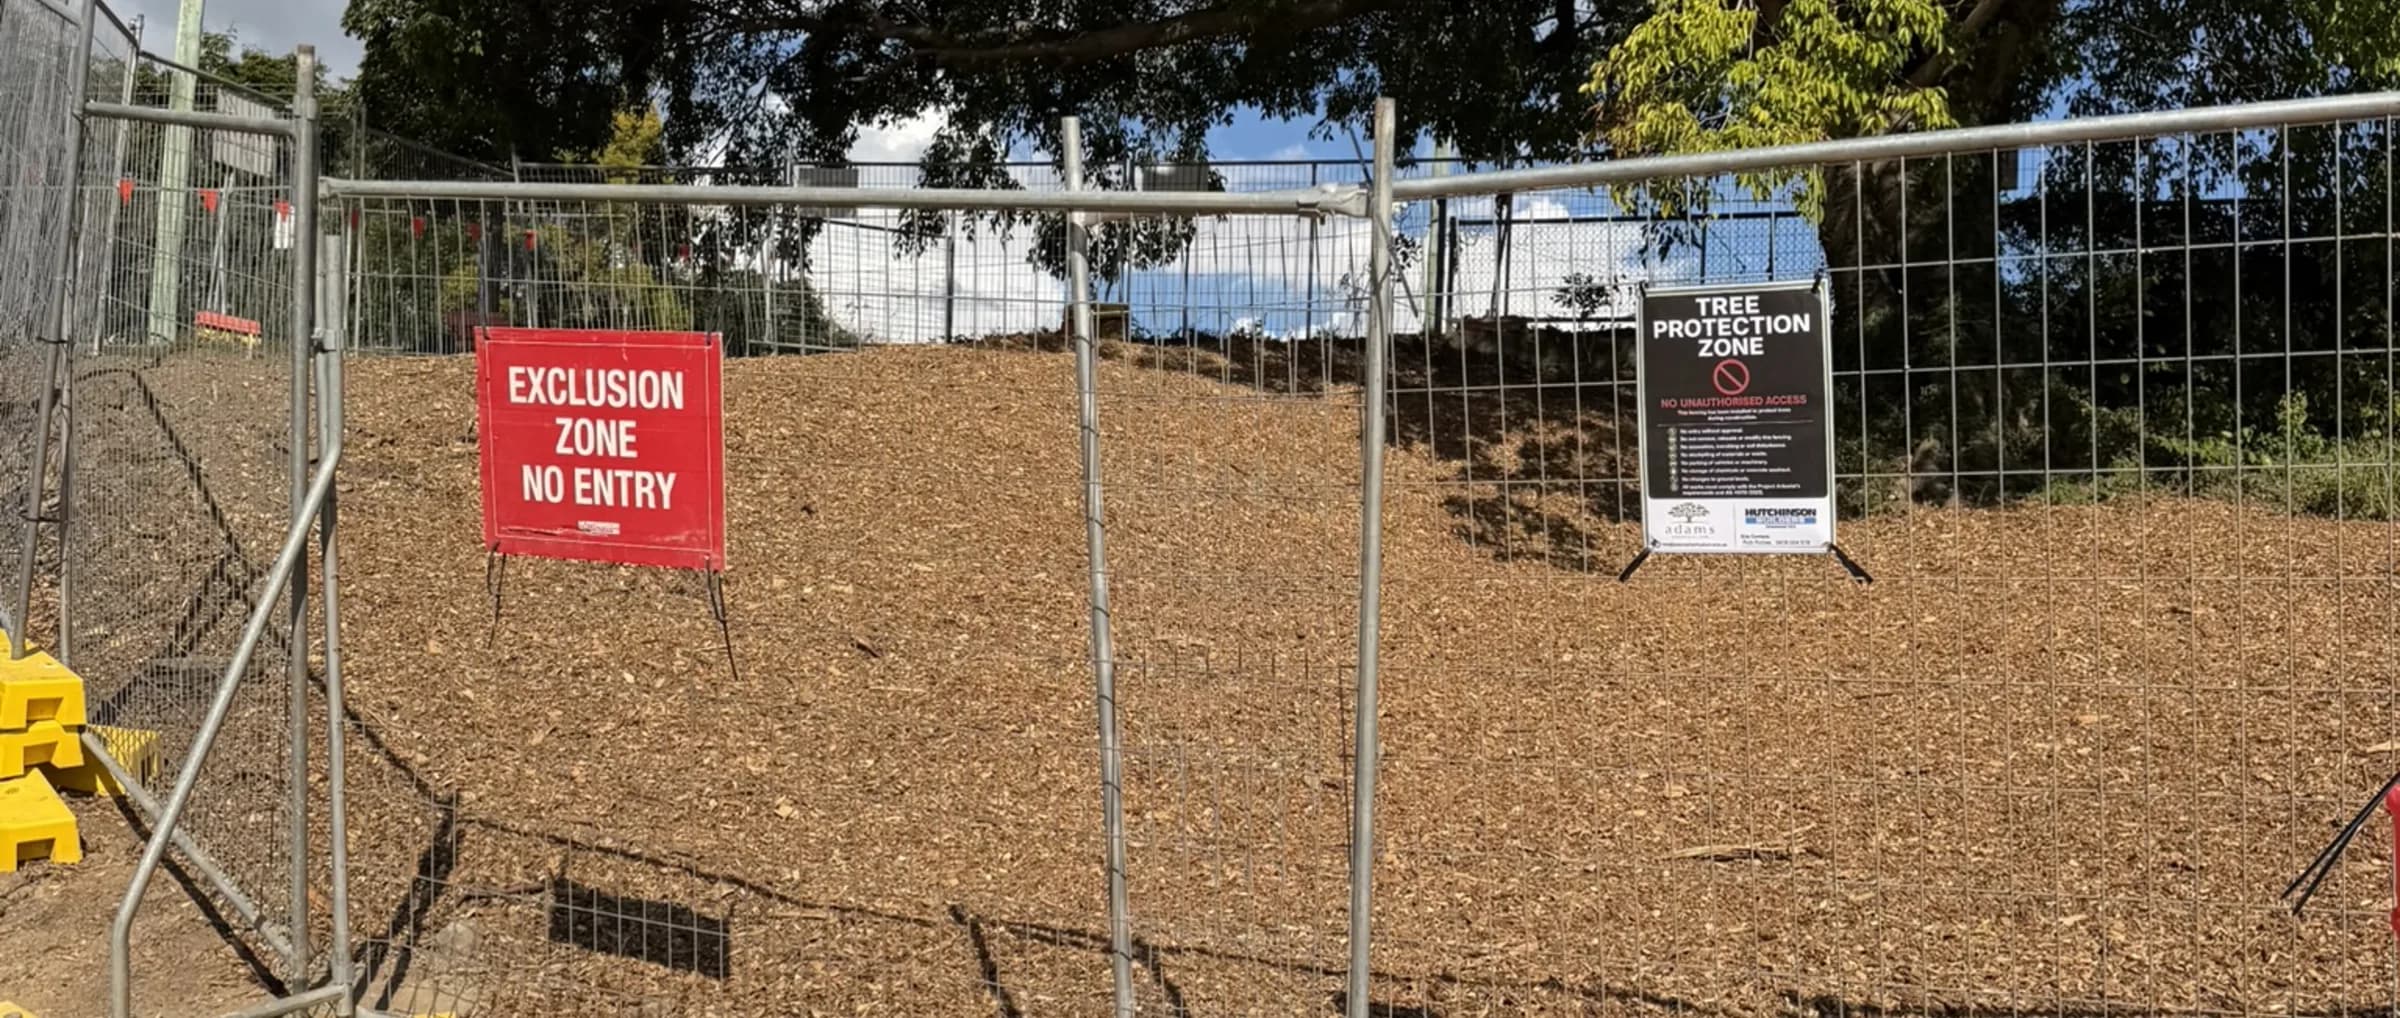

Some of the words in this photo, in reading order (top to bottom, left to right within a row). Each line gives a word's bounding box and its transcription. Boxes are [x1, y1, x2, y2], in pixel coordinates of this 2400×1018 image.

[1695, 295, 1760, 317] TREE
[1653, 313, 1811, 339] PROTECTION
[1697, 336, 1765, 358] ZONE
[508, 366, 684, 410] EXCLUSION
[1660, 398, 1678, 409] NO
[1680, 395, 1763, 409] UNAUTHORISED
[1765, 394, 1808, 406] ACCESS
[555, 417, 638, 458] ZONE
[522, 464, 565, 503] NO
[575, 467, 677, 510] ENTRY
[1745, 508, 1817, 517] HUTCHINSON
[1664, 524, 1716, 535] adams
